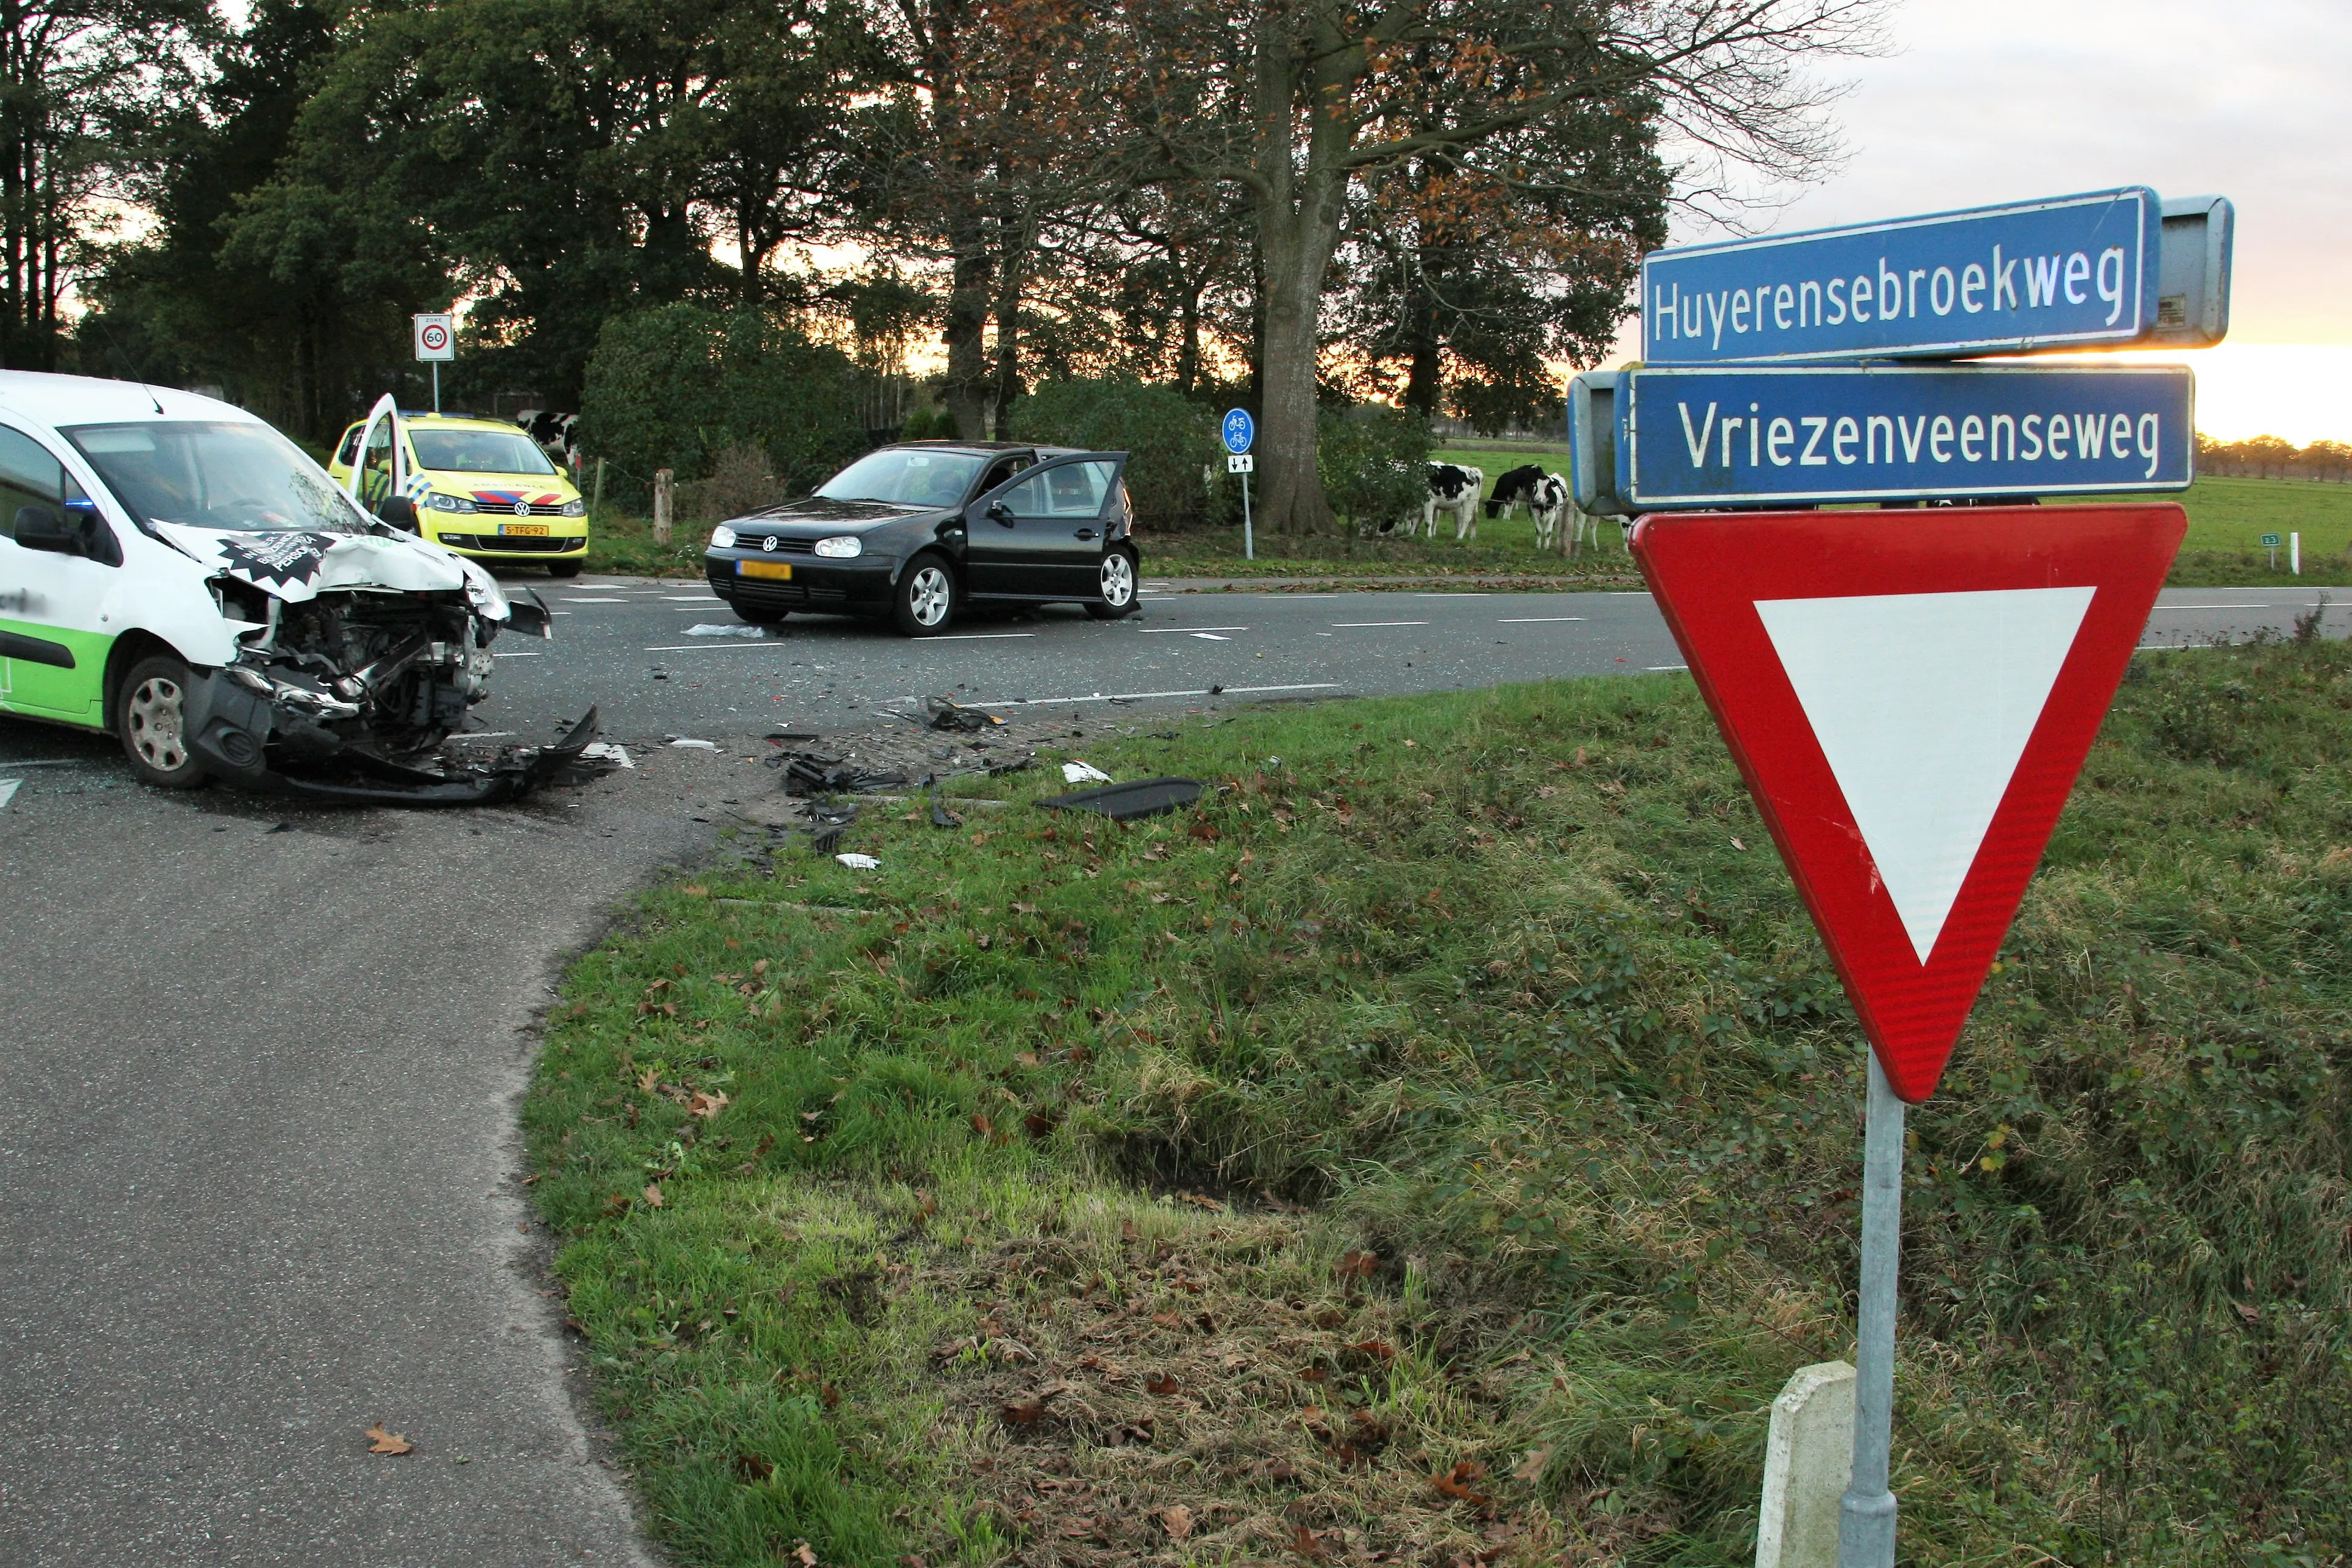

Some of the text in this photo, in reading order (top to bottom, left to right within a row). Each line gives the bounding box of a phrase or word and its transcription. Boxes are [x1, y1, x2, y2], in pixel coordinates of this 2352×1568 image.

[1655, 243, 2124, 351] Huyerensebroekweg
[427, 333, 442, 342] 60
[1678, 401, 2159, 480] Vriezenveenseweg
[506, 526, 545, 535] 5-TFG-92
